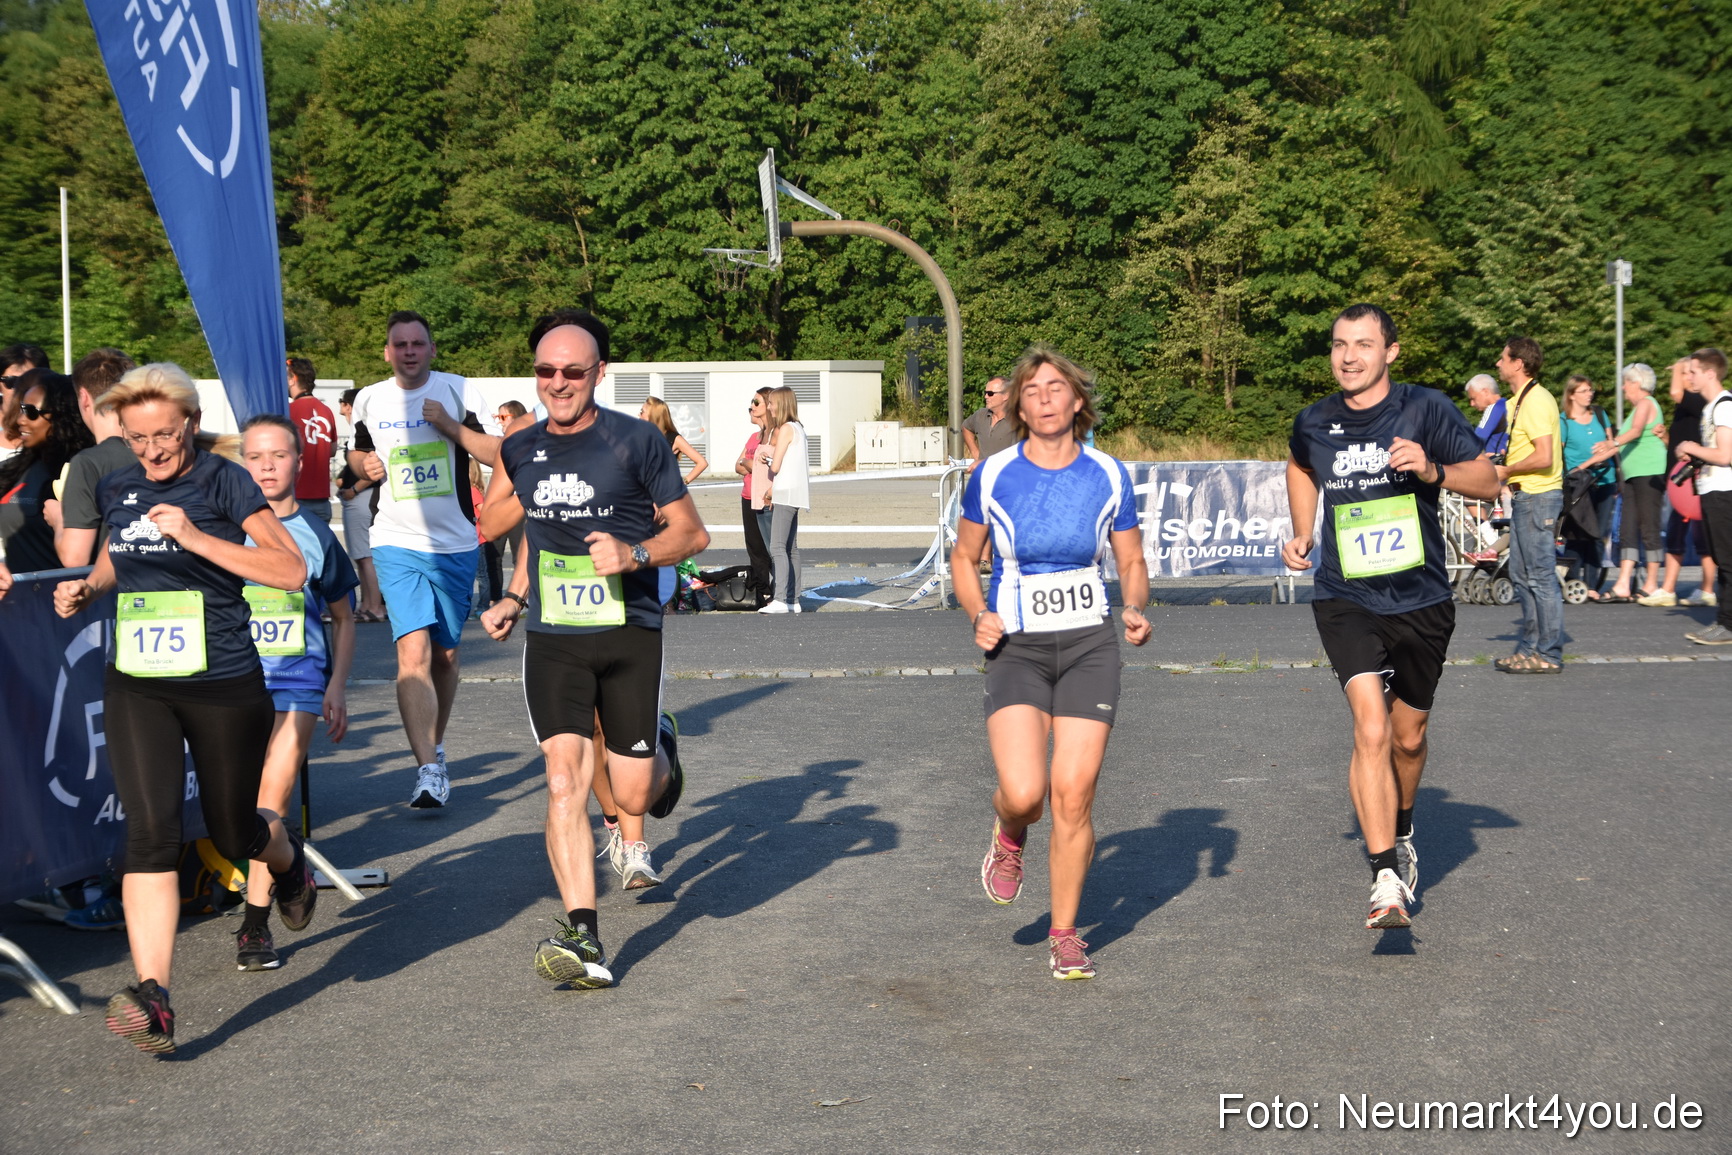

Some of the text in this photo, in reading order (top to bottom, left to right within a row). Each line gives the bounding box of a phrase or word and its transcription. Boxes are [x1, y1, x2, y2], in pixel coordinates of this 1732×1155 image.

[401, 464, 439, 484] 264
[1333, 447, 1392, 477] Burgis
[533, 480, 595, 507] Burgis
[1325, 478, 1354, 489] Weil's
[1359, 473, 1390, 490] guad
[526, 505, 613, 521] Weil's guad is!
[139, 541, 168, 554] guad
[1354, 527, 1405, 556] 172
[556, 584, 605, 606] 170
[1032, 583, 1093, 616] 8919
[133, 626, 186, 653] 175
